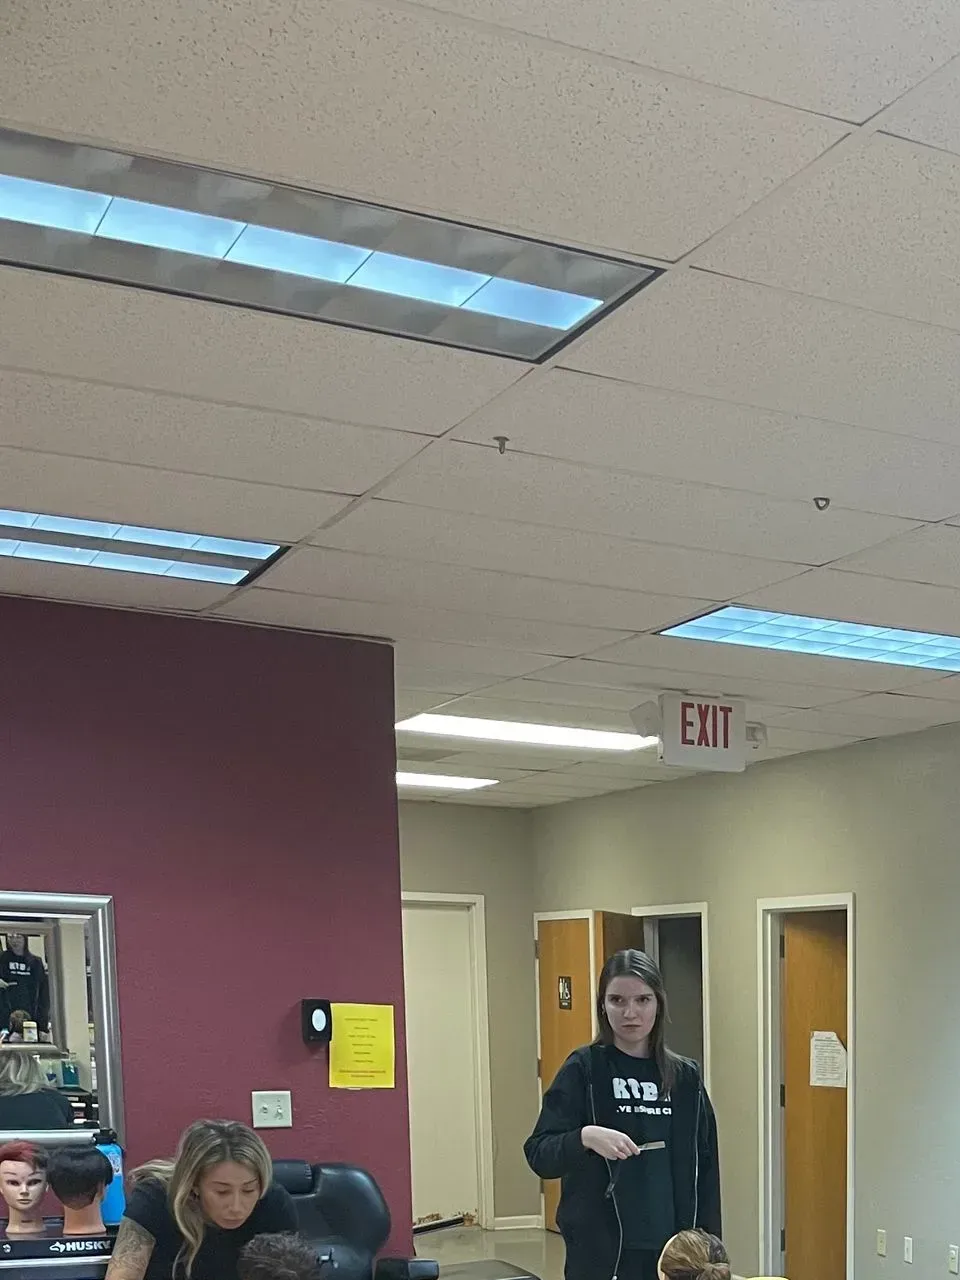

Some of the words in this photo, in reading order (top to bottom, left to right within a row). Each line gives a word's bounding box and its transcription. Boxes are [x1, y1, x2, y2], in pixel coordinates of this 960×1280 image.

[681, 702, 732, 749] EXIT
[612, 1077, 672, 1102] KTB
[65, 1241, 110, 1251] HUSKY
